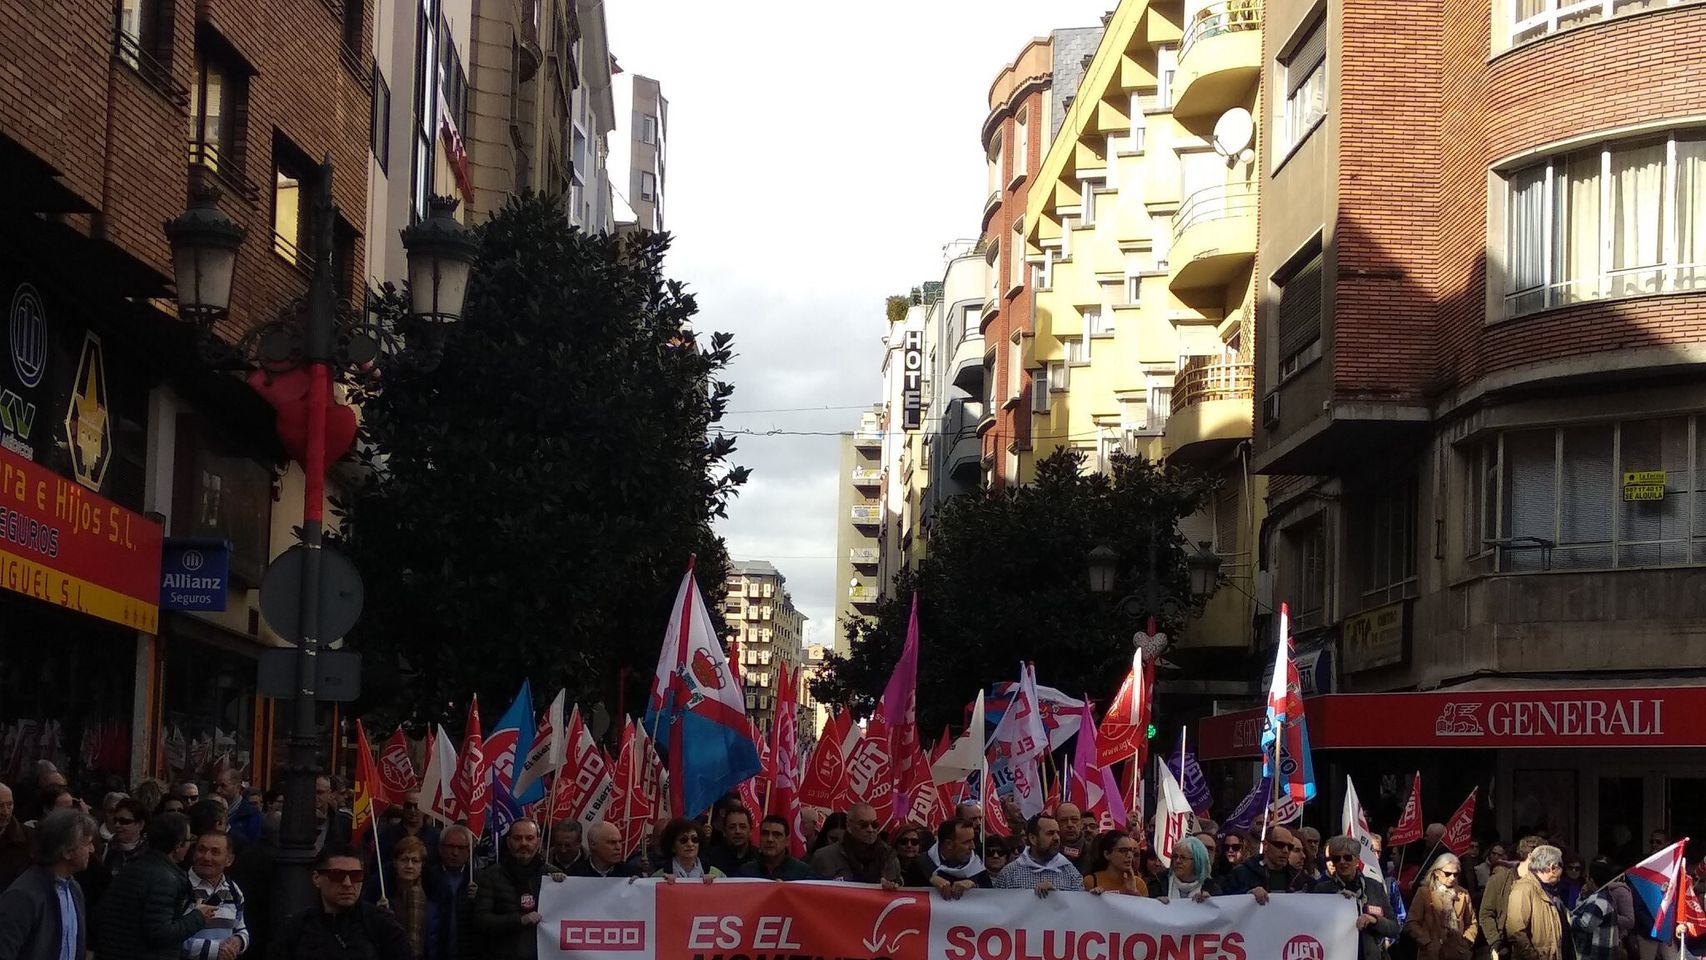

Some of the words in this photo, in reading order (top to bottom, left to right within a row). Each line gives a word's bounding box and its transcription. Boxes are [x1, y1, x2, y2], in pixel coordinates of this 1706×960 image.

[905, 331, 921, 428] HOTEL
[0, 388, 36, 439] KV
[2, 464, 27, 502] ra
[37, 480, 46, 511] e
[56, 479, 100, 535] Hijos
[0, 506, 59, 558] EGUROS
[0, 556, 50, 601] IGUEL
[163, 573, 221, 590] Allianz
[171, 592, 212, 606] Seguros
[1487, 699, 1664, 737] GENERALI
[566, 927, 640, 944] CCOO
[687, 915, 744, 950] ES
[752, 916, 801, 950] EL
[945, 925, 1247, 960] SOLUCIONES
[1288, 941, 1321, 960] UGT
